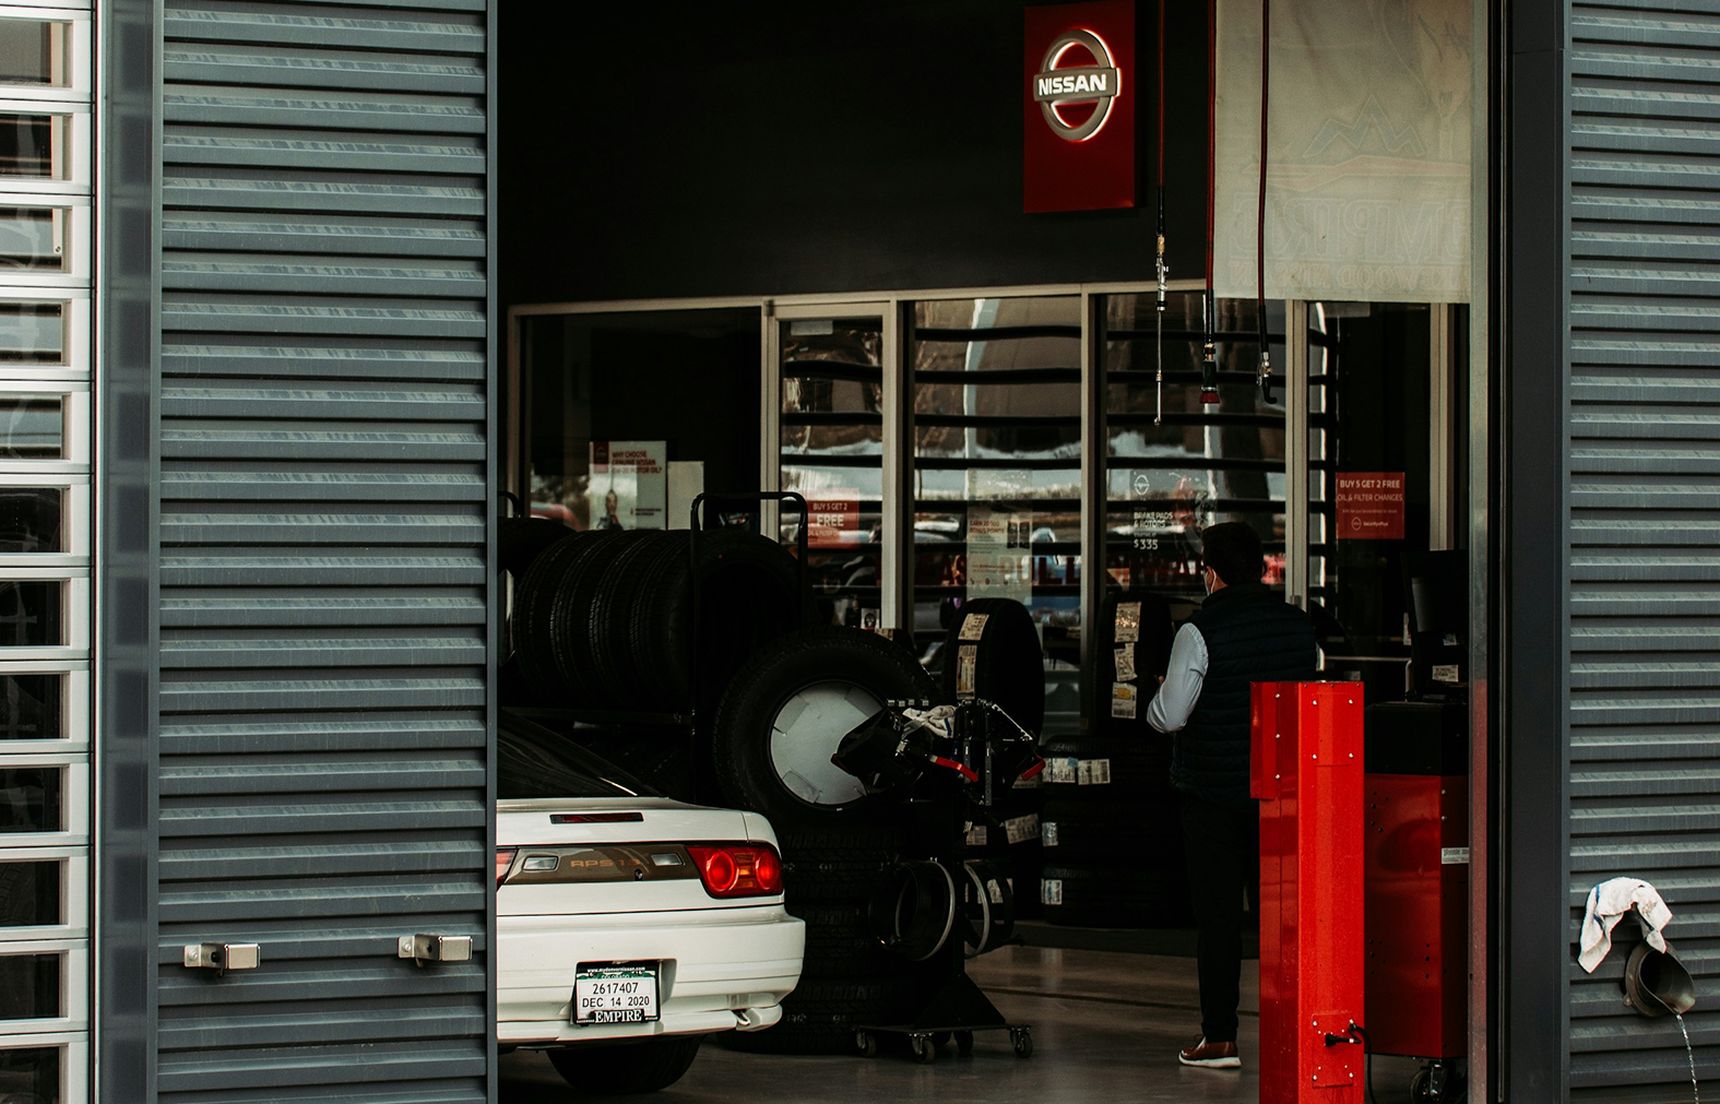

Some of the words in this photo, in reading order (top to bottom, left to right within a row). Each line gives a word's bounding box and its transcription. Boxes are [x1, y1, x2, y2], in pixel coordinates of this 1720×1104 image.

[1038, 73, 1107, 97] NISSAN
[625, 450, 647, 458] CHOOSE
[1340, 479, 1355, 489] BUY
[1356, 480, 1361, 488] 5
[1361, 479, 1375, 488] GET
[1376, 480, 1381, 488] 2
[1382, 479, 1401, 489] FREE
[1337, 494, 1347, 502] OIL
[1354, 493, 1373, 502] FILTER
[813, 502, 826, 511] BUY
[831, 502, 842, 511] GET
[843, 502, 849, 511] 2
[816, 514, 845, 527] FREE
[1133, 511, 1155, 520] BRAKE
[1156, 511, 1173, 520] PADS
[1133, 538, 1159, 551] $335
[592, 982, 639, 994] 2617407
[582, 997, 604, 1008] DEC
[611, 997, 622, 1007] 14
[627, 995, 650, 1007] 2020
[594, 1009, 642, 1023] EMPIRE
